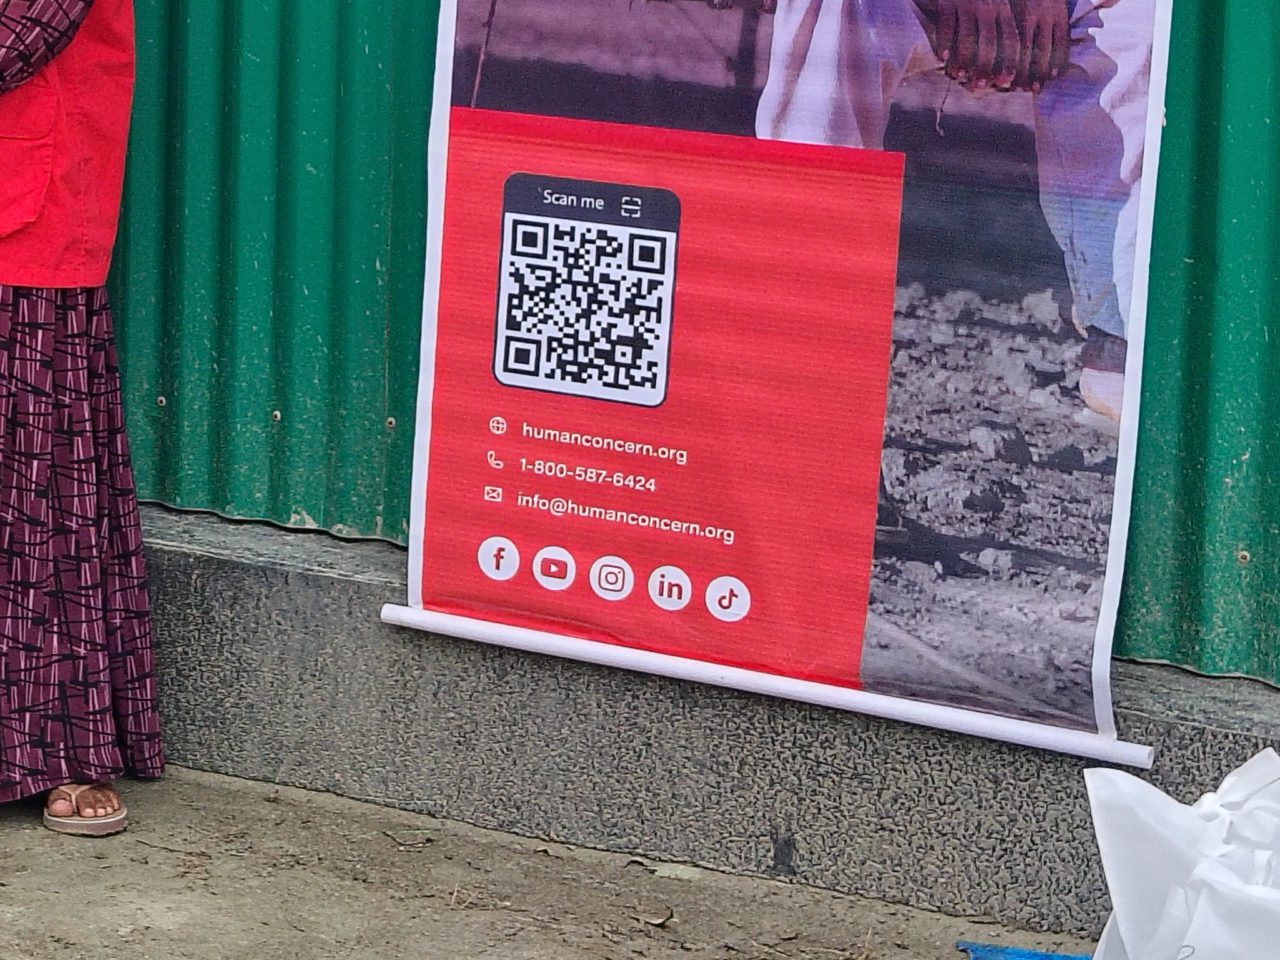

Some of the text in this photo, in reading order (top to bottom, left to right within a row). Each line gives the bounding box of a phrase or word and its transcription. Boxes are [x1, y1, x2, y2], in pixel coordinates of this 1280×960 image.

[543, 189, 605, 210] Scan me
[521, 421, 688, 465] humanconcern.org
[519, 457, 656, 493] 1-800-587-6424
[517, 491, 735, 546] info@humanconcern.org
